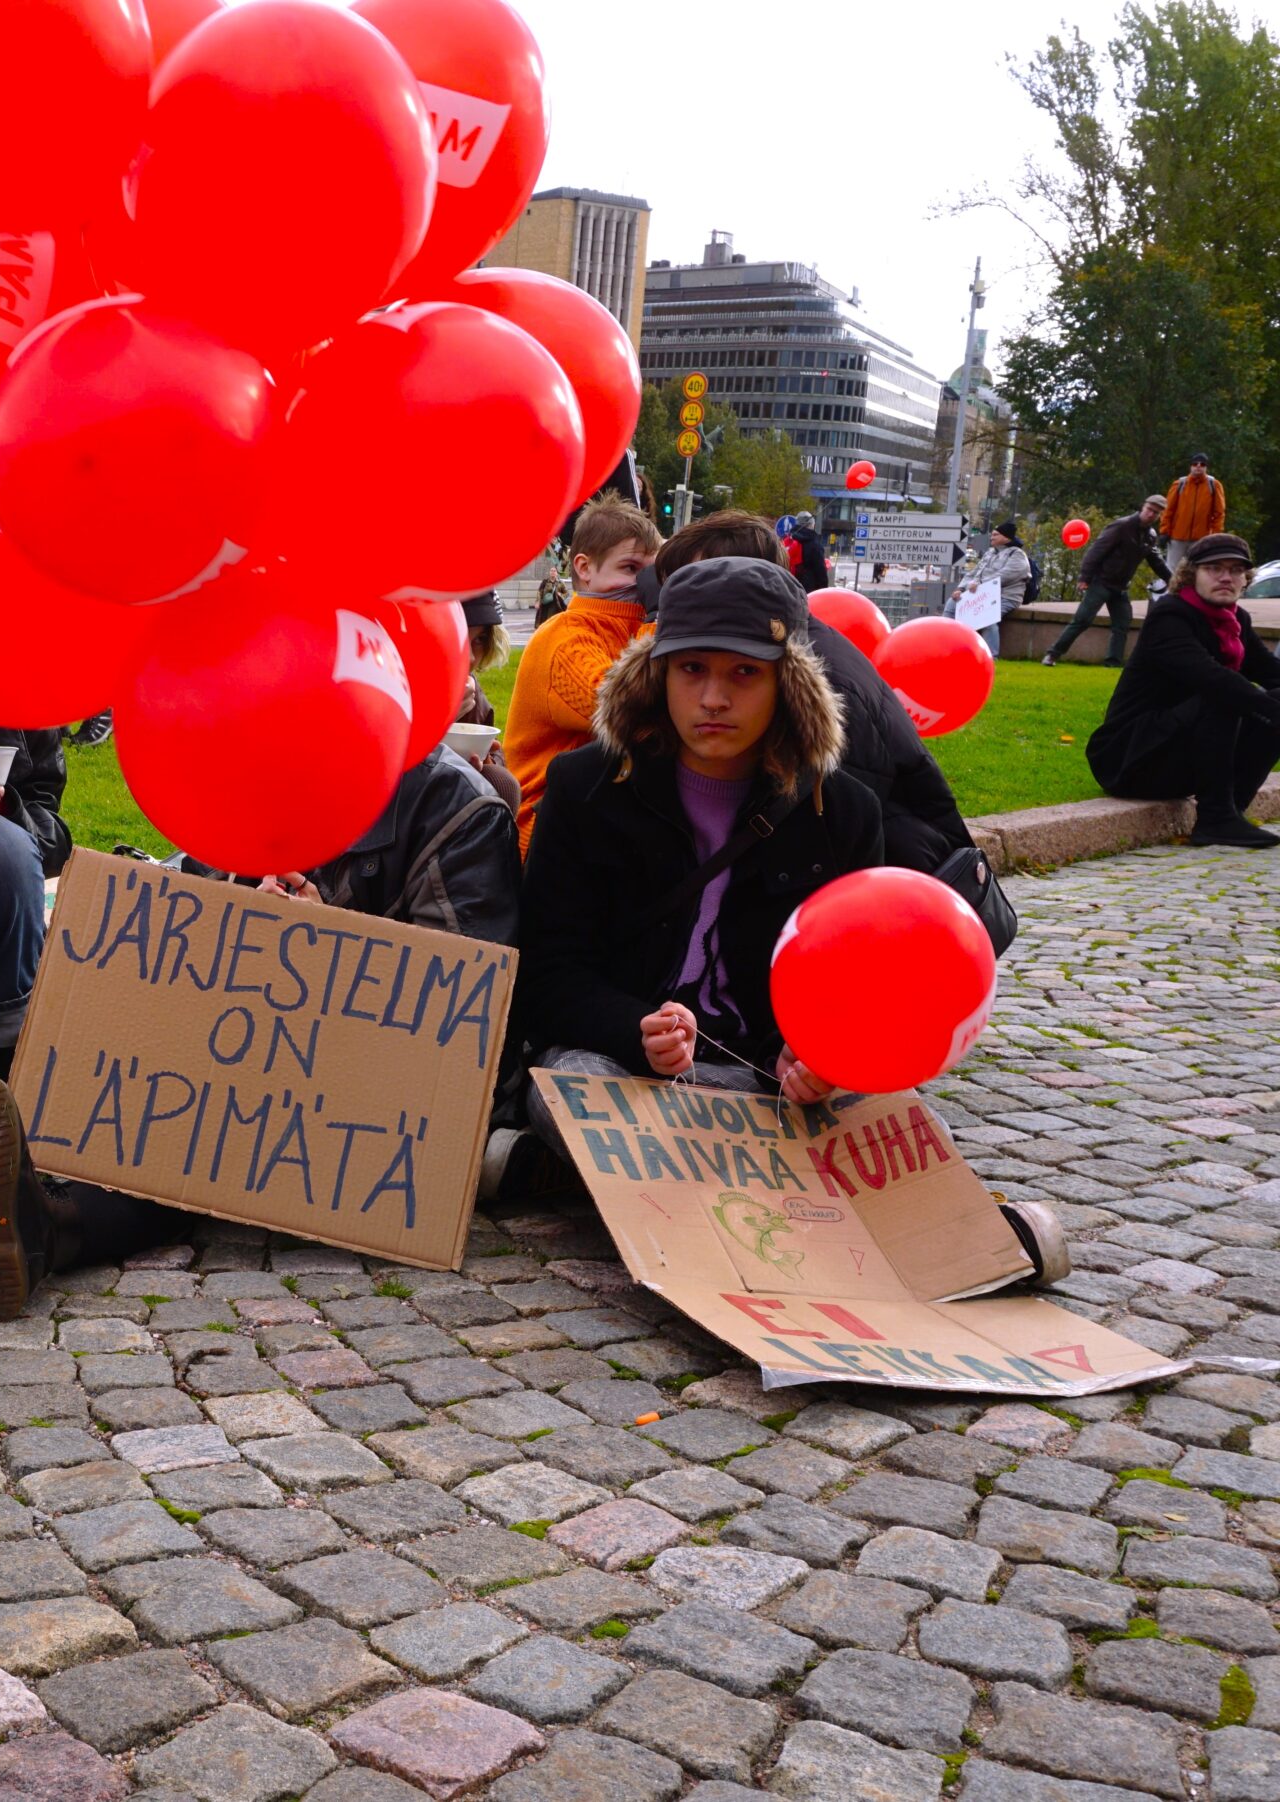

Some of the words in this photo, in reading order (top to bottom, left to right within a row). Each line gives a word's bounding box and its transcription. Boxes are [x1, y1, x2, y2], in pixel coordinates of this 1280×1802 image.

[687, 380, 703, 393] 40t
[872, 529, 932, 538] P-CITYFORUM
[62, 868, 508, 1069] JÄRJESTELMÄ
[207, 1006, 320, 1078] ON
[550, 1074, 639, 1125] EI
[26, 1044, 428, 1229] LÄPIMÄTÄ
[580, 1126, 807, 1193] HÄIVÄÄ
[806, 1104, 952, 1198] KUHA
[720, 1292, 887, 1341] EI
